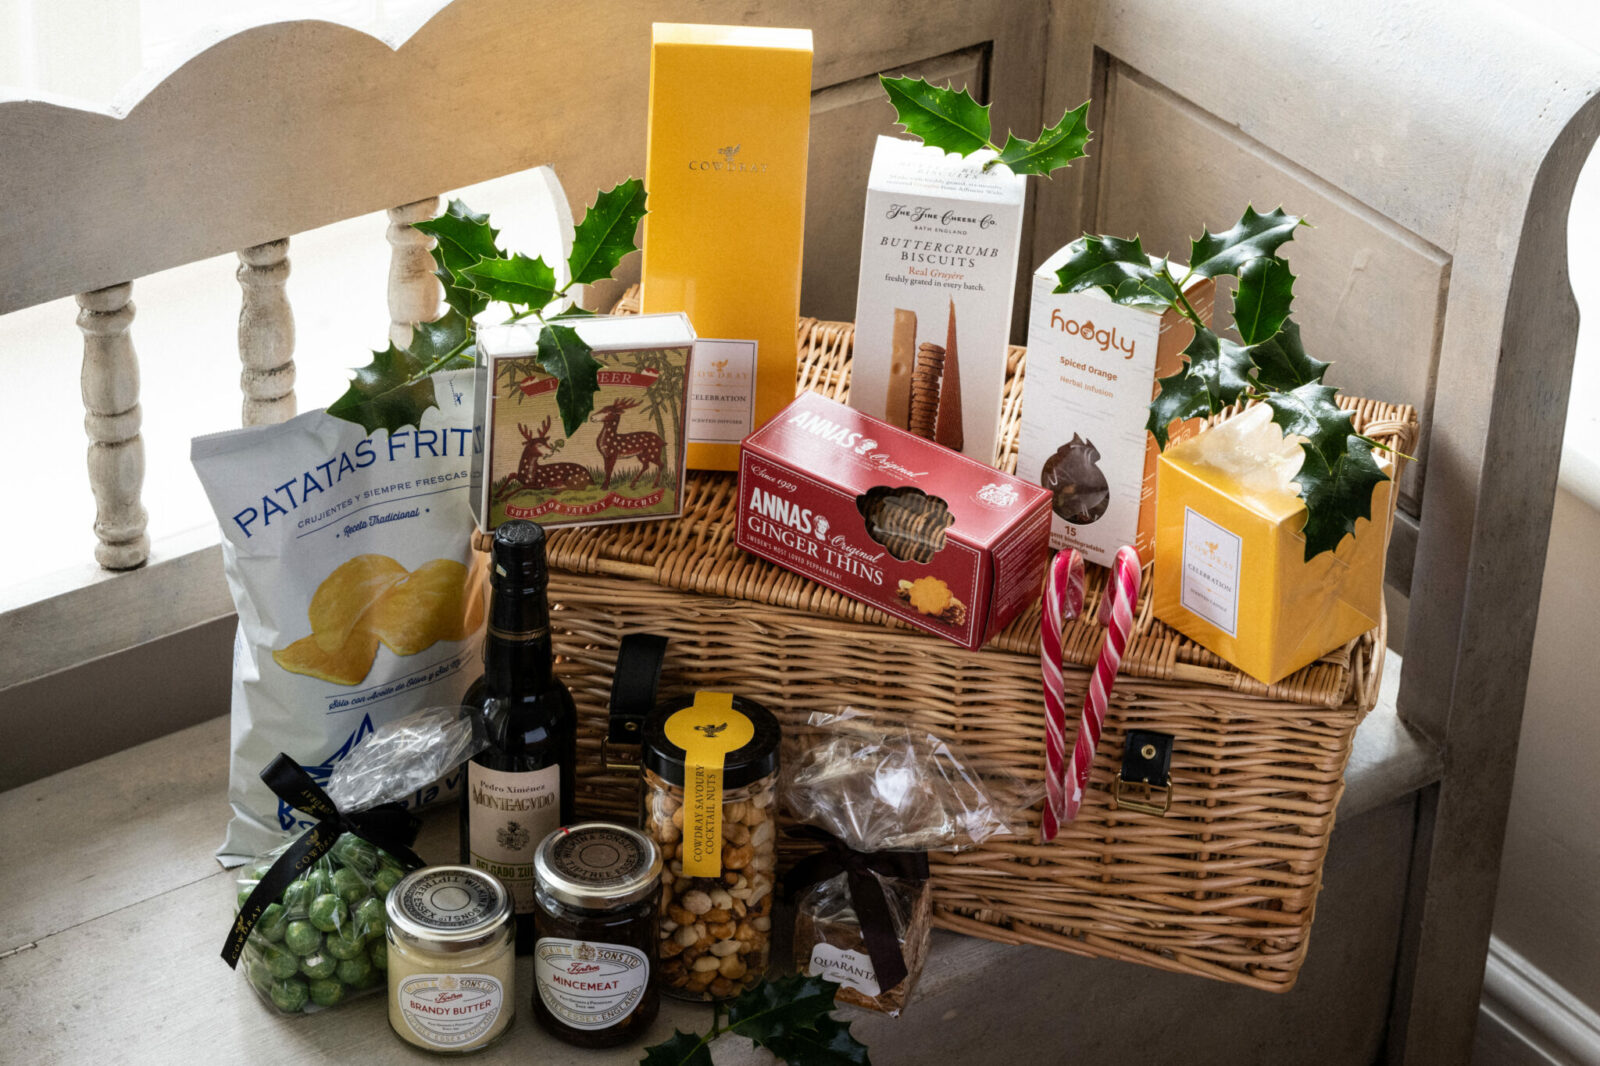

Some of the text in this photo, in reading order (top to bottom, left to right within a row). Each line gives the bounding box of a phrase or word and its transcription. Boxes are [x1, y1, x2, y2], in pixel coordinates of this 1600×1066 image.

[935, 227, 968, 236] ENGLAND
[880, 236, 999, 258] BUTTERCRUMB
[901, 251, 976, 268] BISCUITS
[885, 274, 986, 291] freshly grated in every batch.
[908, 266, 928, 277] Real
[598, 371, 632, 385] EER
[1060, 356, 1118, 381] Spiced Orange
[1060, 375, 1114, 398] Herbal Infusion
[788, 410, 863, 449] ANNAS
[233, 438, 377, 538] PATATAS
[751, 464, 798, 493] Since 1929
[297, 497, 353, 529] CRUJIENTES
[363, 481, 412, 499] SIEMPRE
[415, 470, 468, 488] FRESCAS
[612, 494, 660, 508] MATCHES
[749, 487, 885, 563] ANNAS Original
[1064, 525, 1077, 537] 15
[747, 516, 884, 586] GINGER THINS
[1187, 563, 1232, 593] CELEBRATION
[480, 780, 504, 793] Pedro
[693, 764, 705, 863] COWDRAY SAVOURY
[705, 773, 716, 855] COCKTAIL NUTS
[597, 950, 623, 961] SONS
[814, 956, 878, 981] QUARANTA
[460, 979, 481, 989] SONS
[552, 973, 620, 991] MINCEMEAT
[410, 999, 492, 1016] BRANDY BUTTER
[601, 989, 639, 1020] ENGLAND
